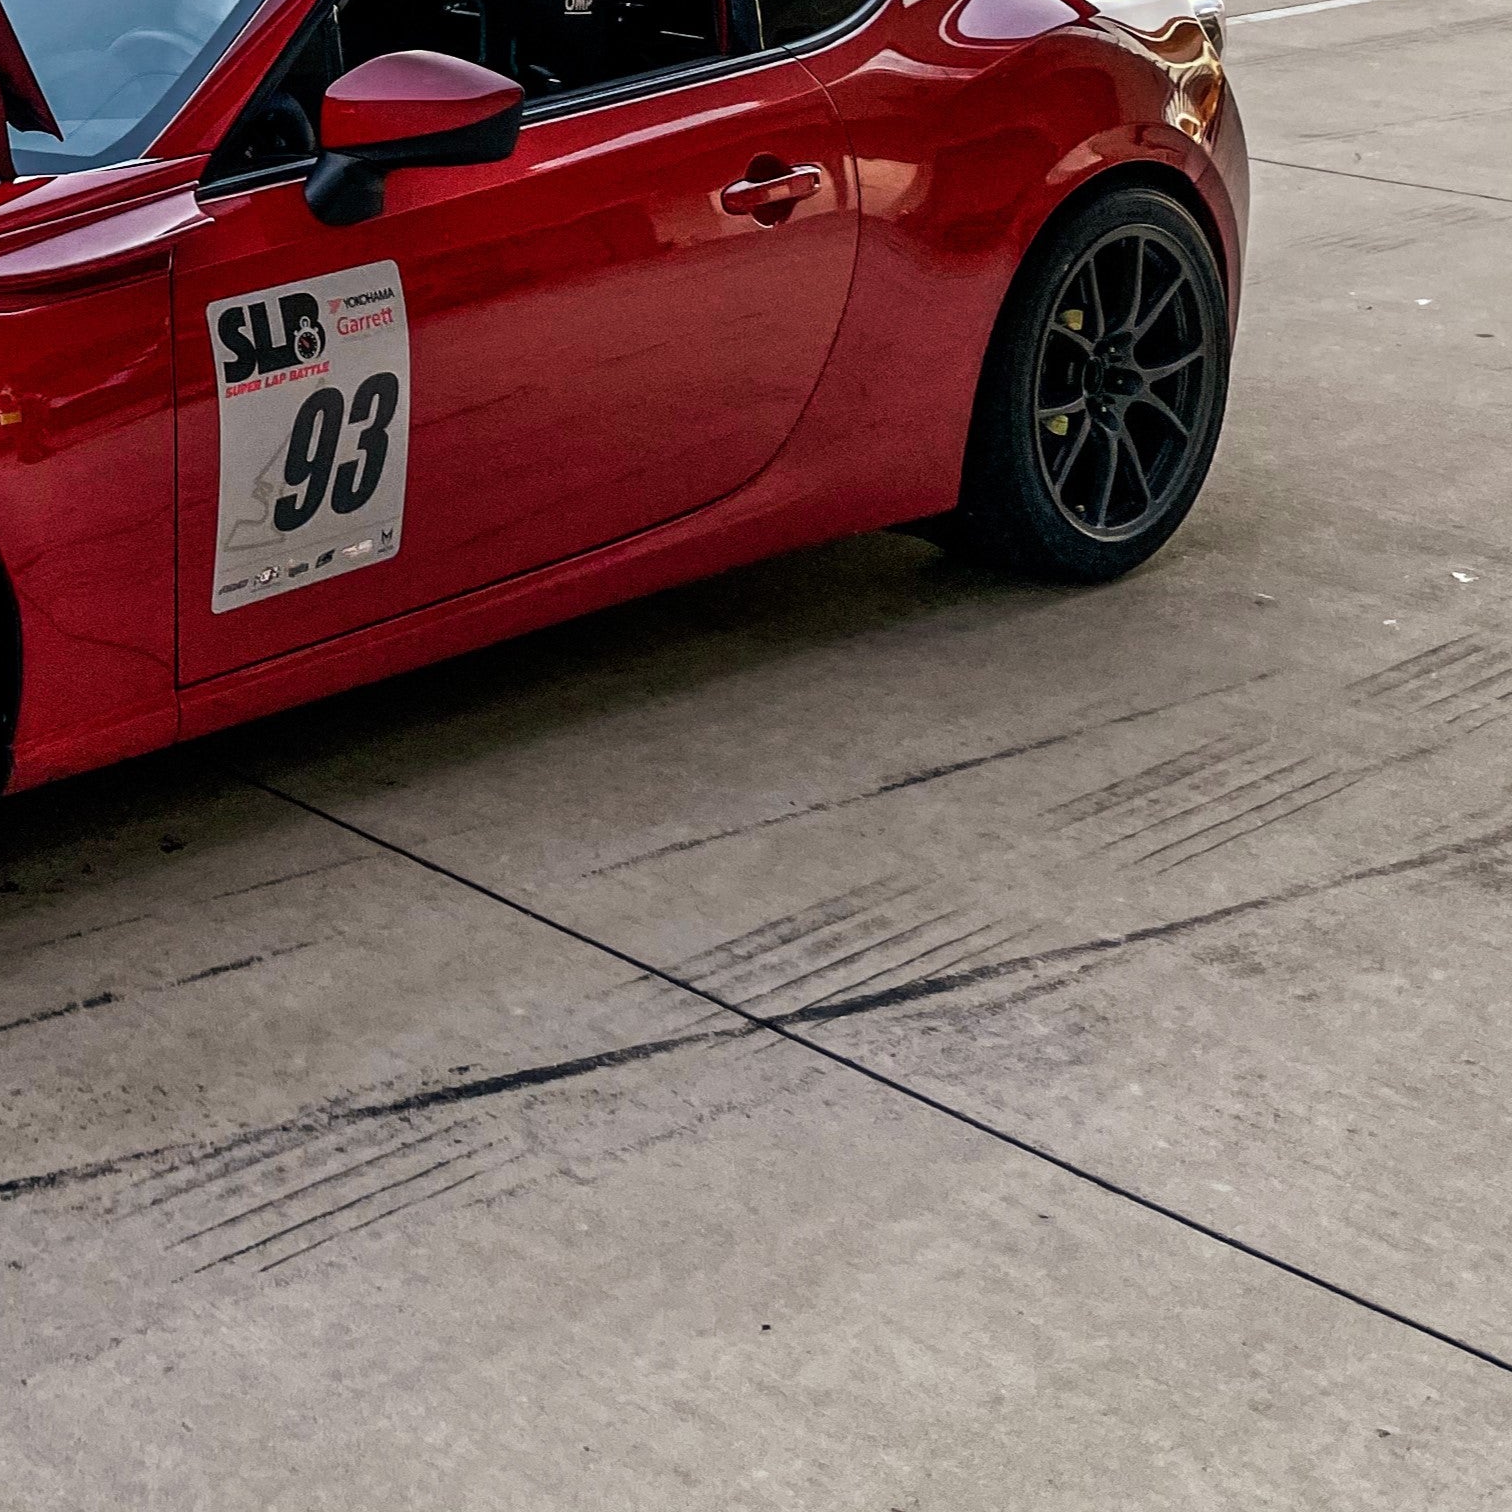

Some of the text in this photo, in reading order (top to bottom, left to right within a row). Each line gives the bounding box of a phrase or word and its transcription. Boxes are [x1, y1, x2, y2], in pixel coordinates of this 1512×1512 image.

[343, 287, 395, 309] YOKOHAMA
[218, 292, 326, 383] SLB
[337, 307, 394, 335] Garrett
[225, 361, 330, 398] SUPER LAP BATTLE
[274, 372, 399, 532] 93
